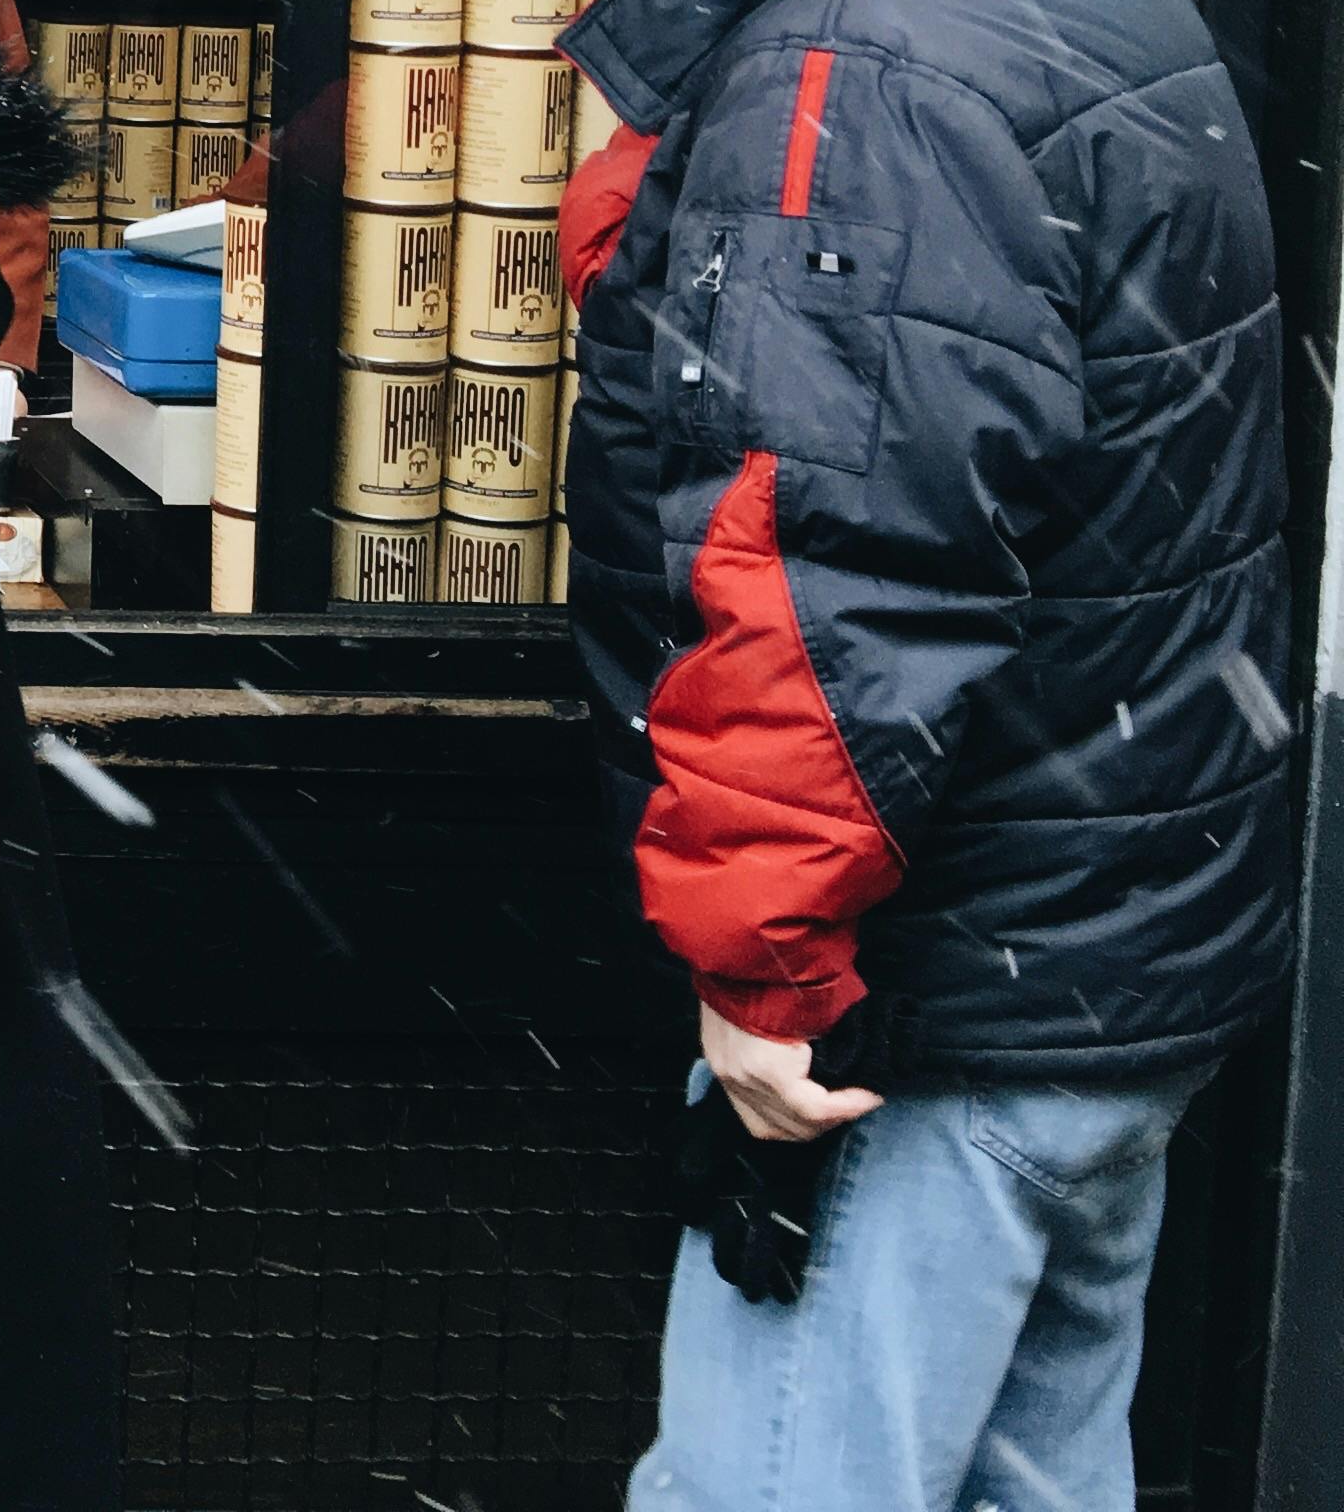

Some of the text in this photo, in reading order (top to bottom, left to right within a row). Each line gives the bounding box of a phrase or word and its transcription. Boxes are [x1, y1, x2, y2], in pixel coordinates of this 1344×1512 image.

[118, 32, 165, 86] KAKAO
[191, 33, 239, 87] KAKAO
[225, 215, 263, 294] KAK
[398, 224, 453, 308] KAKA
[449, 378, 526, 468] KAKAO
